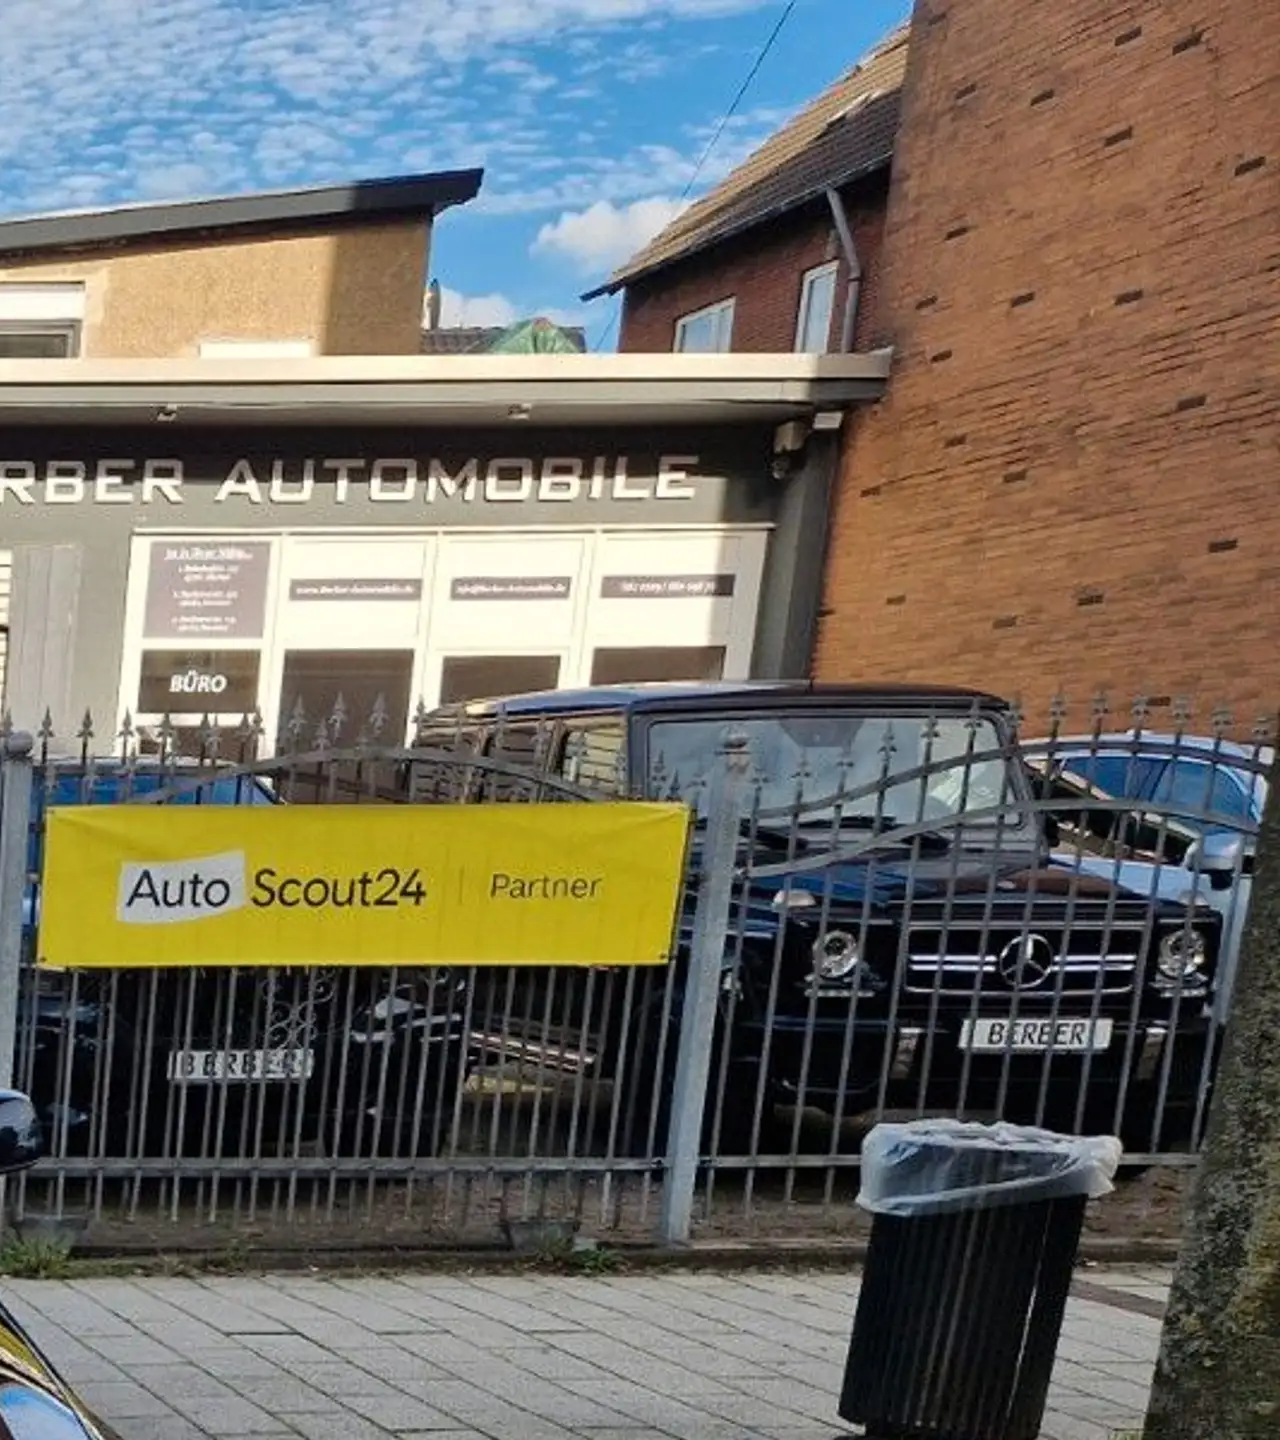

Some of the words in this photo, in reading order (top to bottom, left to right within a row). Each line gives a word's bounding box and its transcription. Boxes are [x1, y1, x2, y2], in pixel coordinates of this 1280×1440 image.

[215, 455, 699, 503] AUTOMOBILE
[168, 669, 228, 693] BÜRO
[126, 868, 231, 908] Auto
[251, 868, 427, 908] Scout24
[489, 872, 603, 899] Partner
